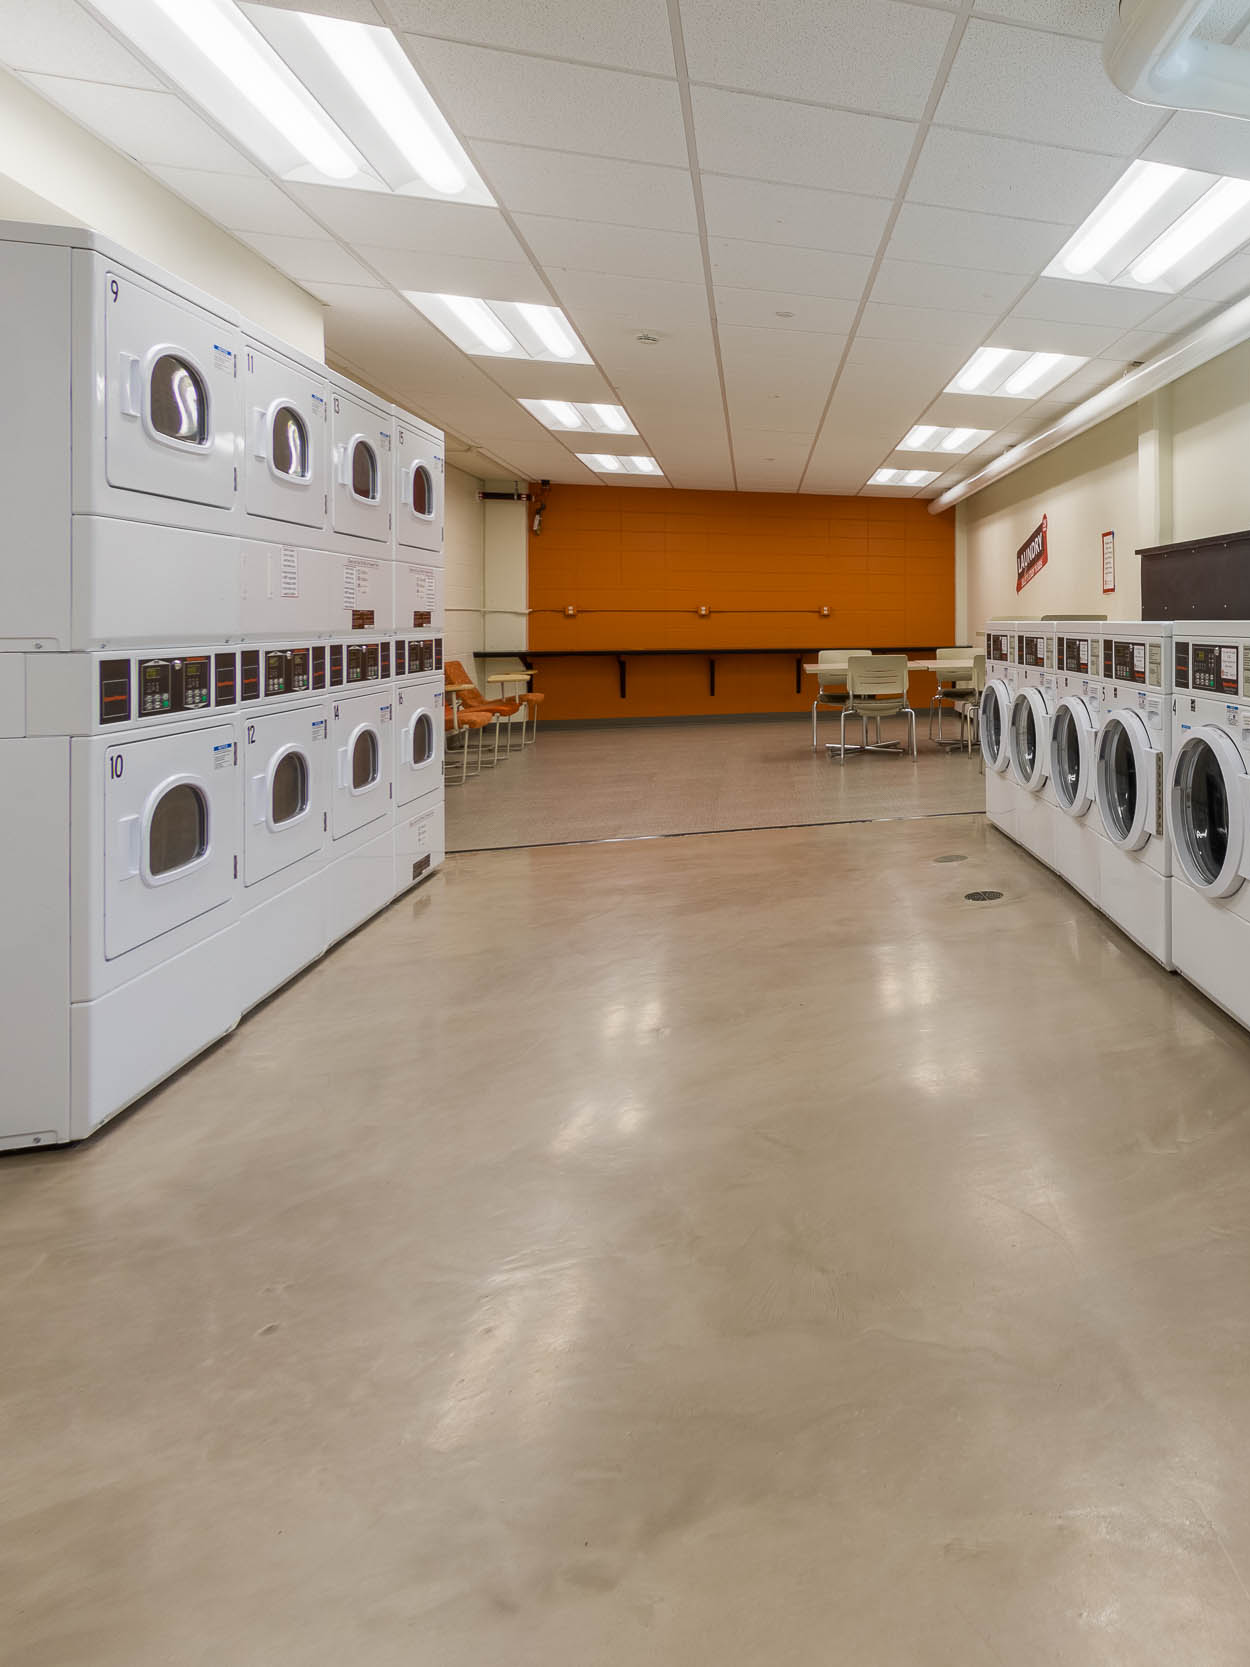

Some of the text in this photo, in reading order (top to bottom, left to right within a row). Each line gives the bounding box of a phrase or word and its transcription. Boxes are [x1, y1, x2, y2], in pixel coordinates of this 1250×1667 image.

[110, 279, 119, 303] 9
[1017, 532, 1043, 573] LAUNDRY
[247, 725, 256, 744] 12
[110, 754, 124, 779] 10
